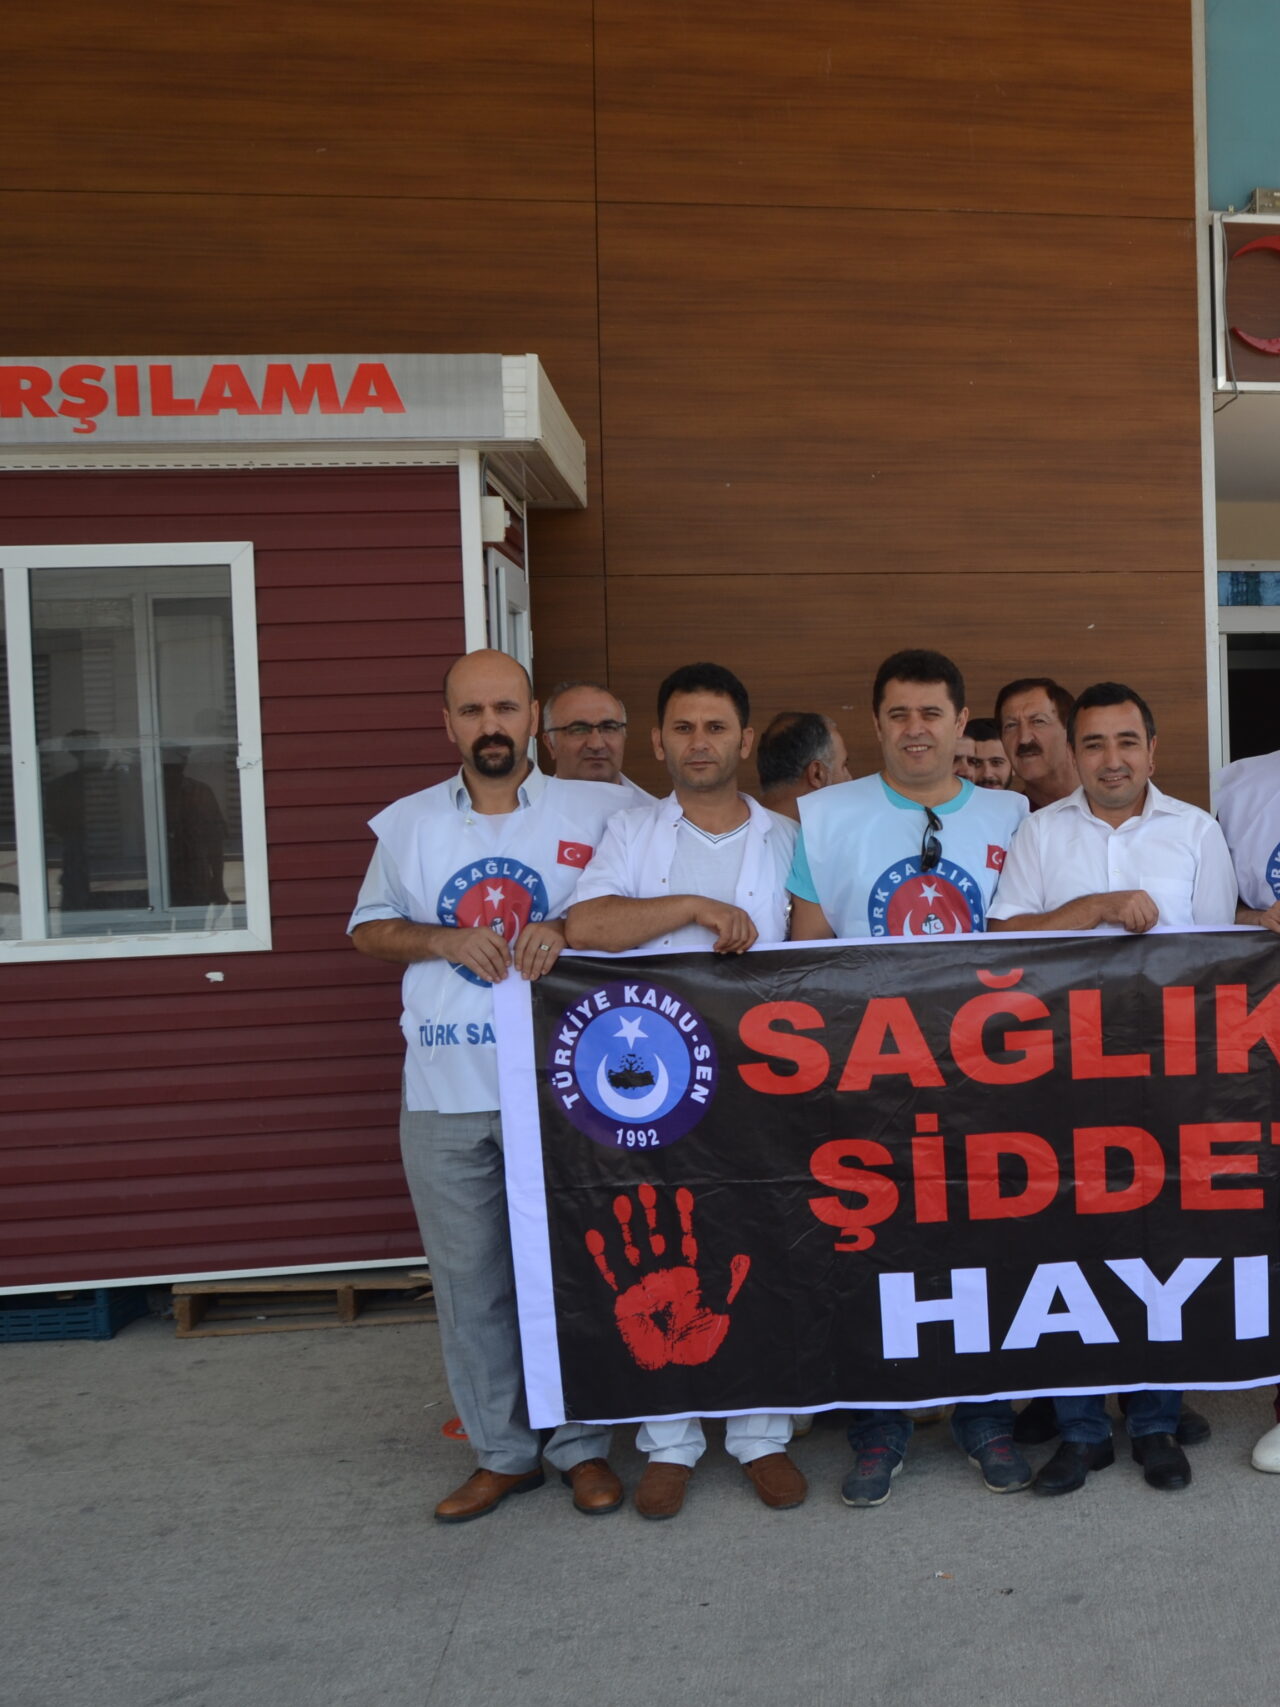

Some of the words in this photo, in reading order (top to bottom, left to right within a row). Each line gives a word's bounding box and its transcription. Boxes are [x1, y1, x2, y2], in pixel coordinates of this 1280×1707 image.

[0, 362, 407, 435] RŞILAMA
[454, 860, 539, 891] SAĞLIK
[888, 862, 973, 893] SALIK
[419, 1019, 460, 1047] TÜRK
[551, 990, 611, 1110] TÜRKİYE
[624, 985, 713, 1105] KAMU-SEN
[616, 1128, 661, 1148] 1992
